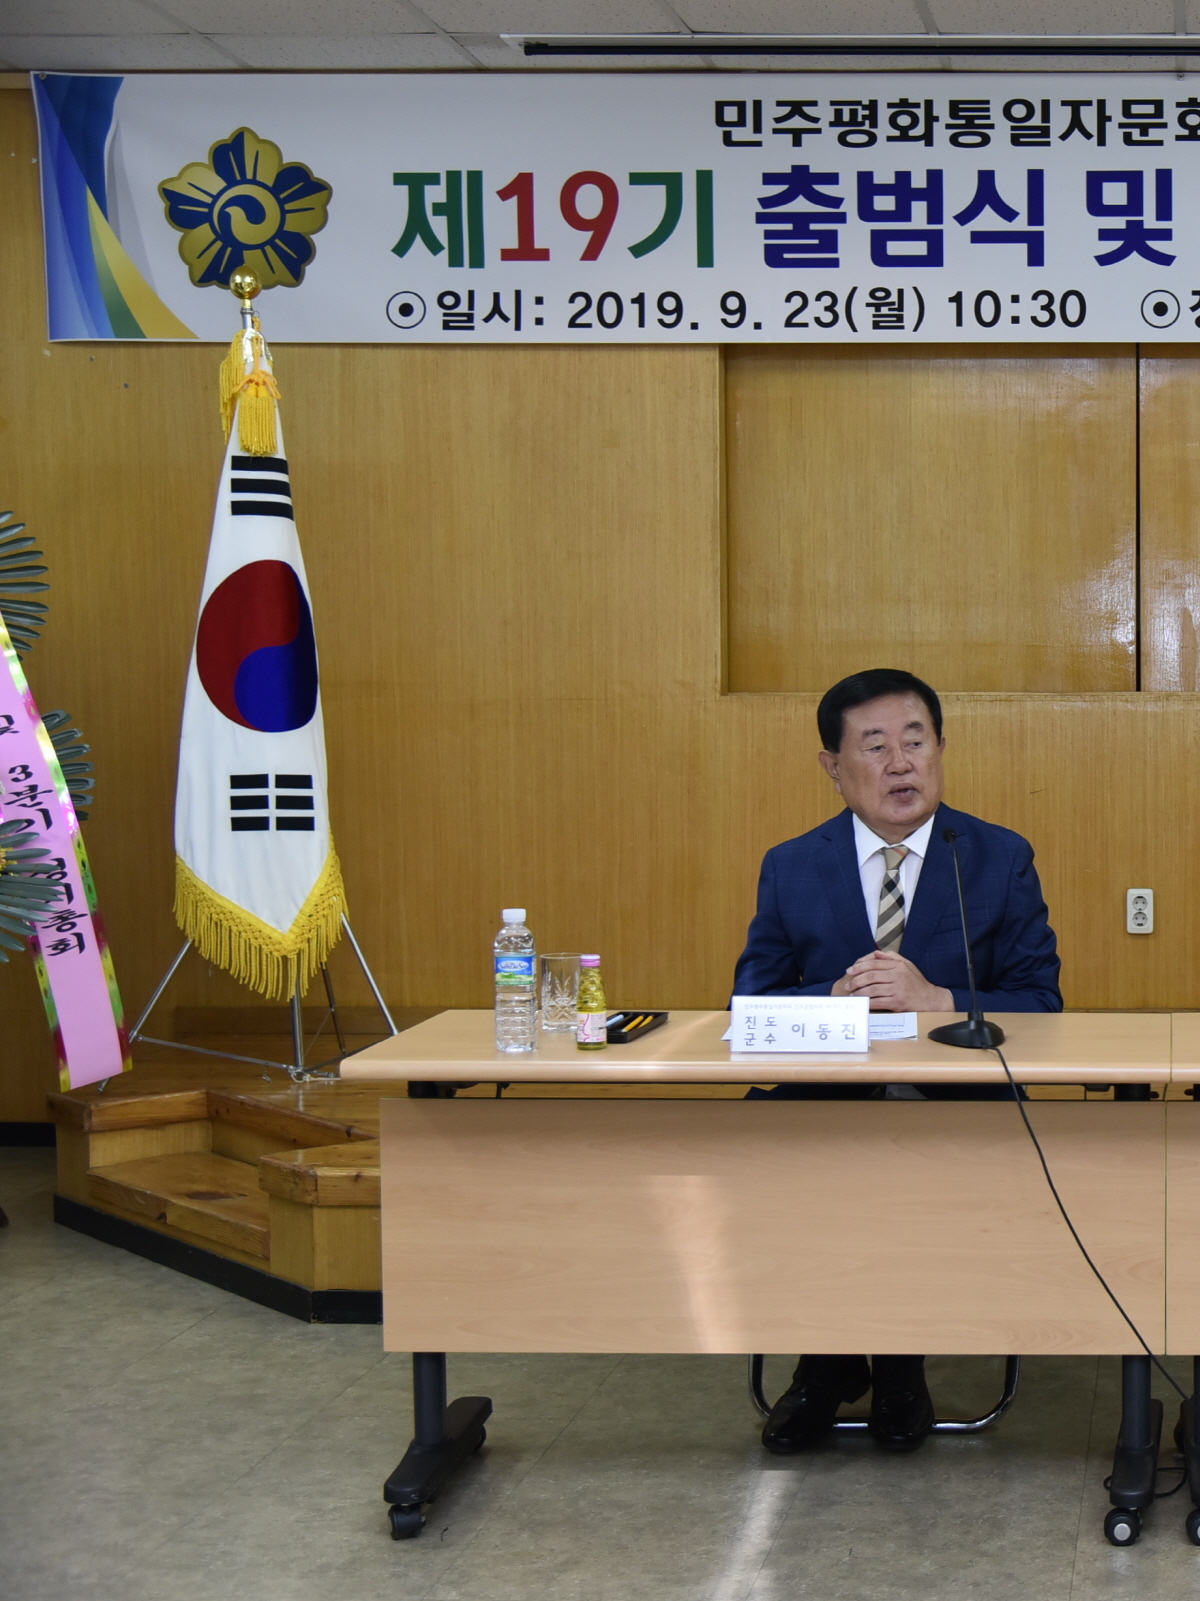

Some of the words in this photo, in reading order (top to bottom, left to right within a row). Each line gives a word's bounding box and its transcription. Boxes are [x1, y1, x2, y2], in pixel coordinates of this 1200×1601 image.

[391, 169, 715, 269] 제19기
[755, 164, 1045, 269] 출범식
[1085, 168, 1178, 267] 및
[436, 289, 544, 331] 일시:
[567, 290, 699, 331] 2019.
[720, 290, 762, 330] 9.
[784, 286, 925, 333] 23(월)
[948, 289, 1088, 328] 10:30
[744, 1016, 777, 1030] 진도
[791, 1022, 856, 1041] 이동진
[743, 1032, 777, 1047] 군수
